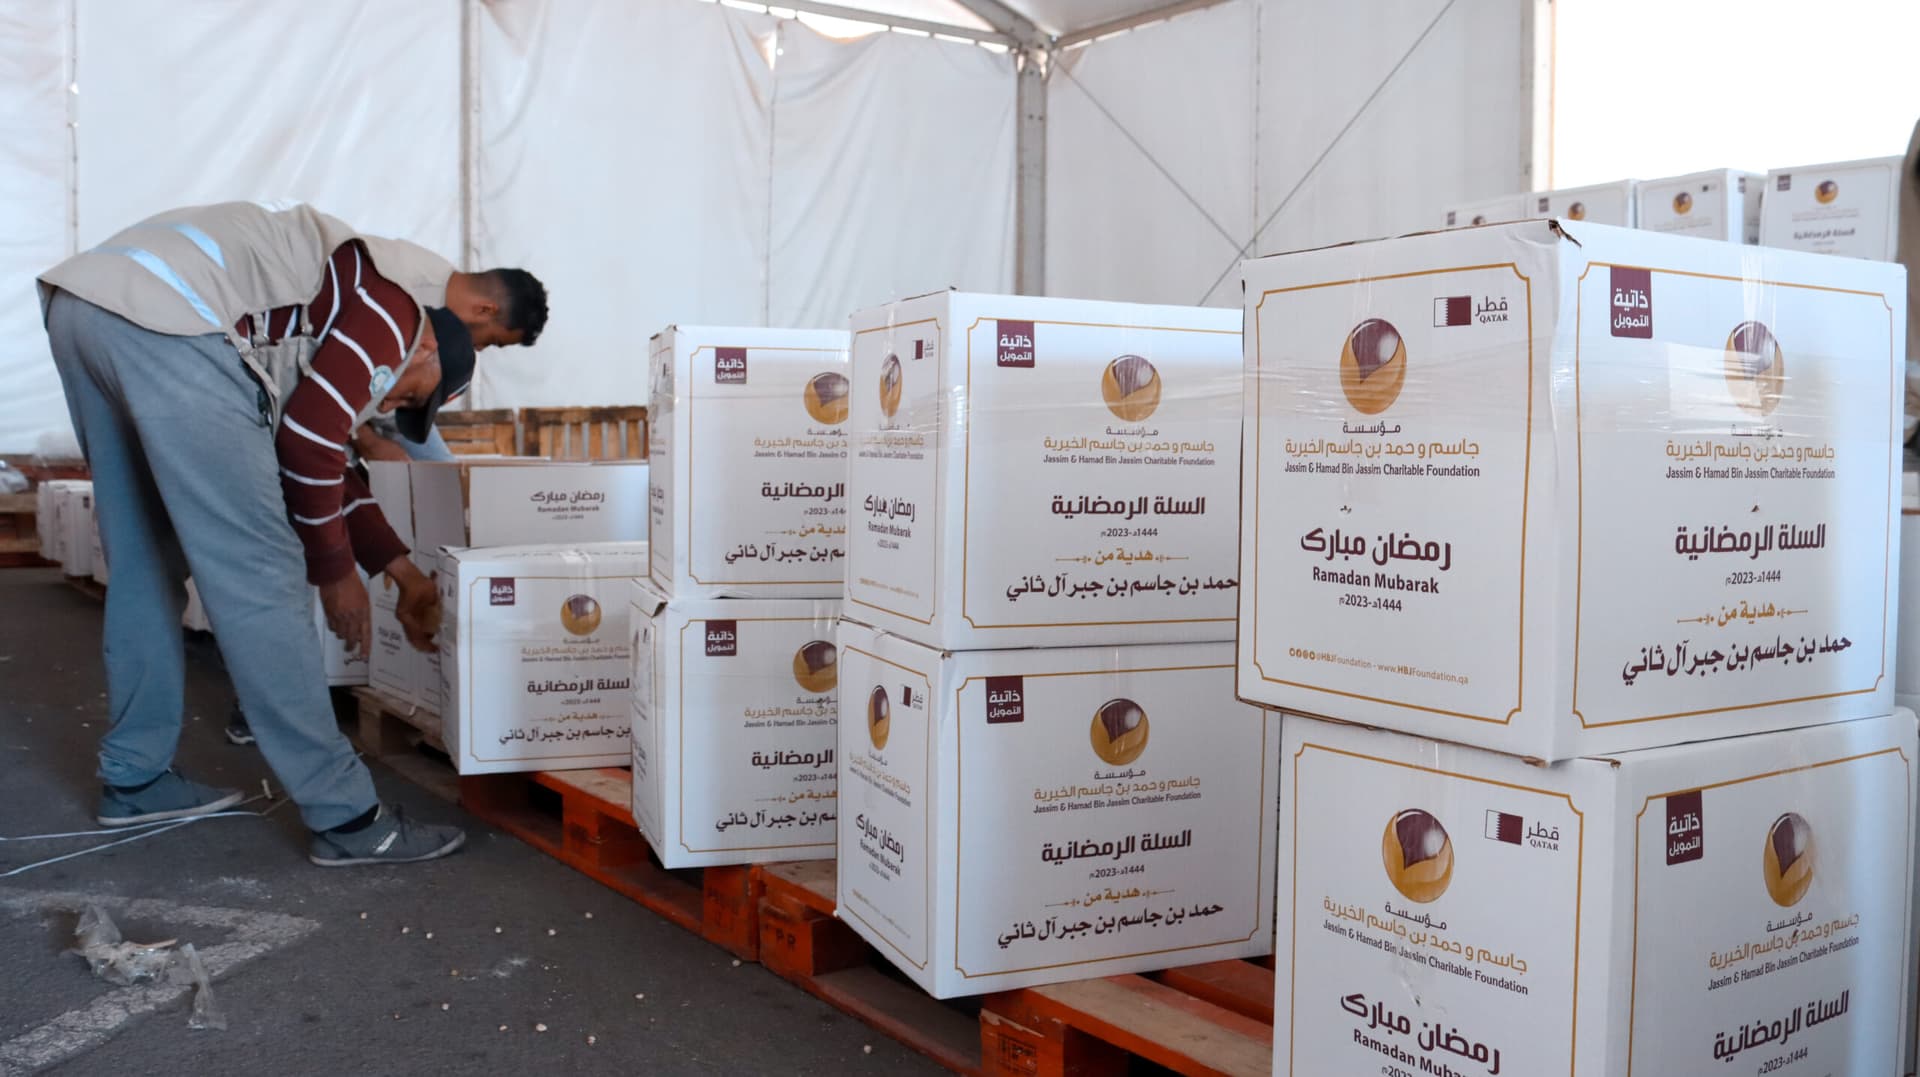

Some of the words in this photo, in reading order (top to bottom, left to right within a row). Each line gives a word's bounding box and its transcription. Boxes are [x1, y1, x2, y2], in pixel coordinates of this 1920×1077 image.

[1475, 296, 1508, 316] قطر
[1614, 288, 1648, 311] ذاتية
[1480, 314, 1508, 323] QATAR
[1614, 313, 1649, 328] التمويل
[1000, 334, 1032, 350] ذاتية
[717, 358, 744, 369] ذاتية
[1000, 352, 1032, 362] التمويل
[1106, 426, 1159, 438] مؤسسة
[1343, 421, 1401, 436] مؤسسة
[1286, 439, 1323, 456] الخيرية
[1327, 440, 1362, 456] جاسم
[1365, 446, 1381, 457] بن
[1387, 446, 1413, 454] حمد
[1419, 446, 1425, 458] و
[1429, 439, 1479, 459] جاسم
[1666, 441, 1711, 461] الخيرية
[1714, 443, 1751, 461] جاسم
[1754, 445, 1768, 461] بن
[1773, 444, 1793, 458] حمد
[1797, 448, 1802, 462] و
[1804, 444, 1834, 460] جاسم
[1043, 455, 1068, 464] Jassim
[1079, 455, 1103, 464] Hamad
[1106, 456, 1117, 464] Bin
[1119, 456, 1142, 464] Jassim
[1144, 456, 1177, 465] Charitable
[1179, 457, 1215, 466] Foundation
[1285, 462, 1307, 472] Jassim
[1309, 463, 1314, 472] &
[1316, 463, 1340, 474] Hamad
[1342, 463, 1353, 474] Bin
[1355, 463, 1381, 475] Jassim
[1384, 463, 1424, 476] Charitable
[1426, 464, 1479, 476] Foundation
[1666, 467, 1693, 479] Jassim
[1696, 467, 1701, 478] &
[1704, 467, 1729, 479] Hamad
[1731, 467, 1742, 478] Bin
[1744, 467, 1768, 479] Jassim
[1770, 467, 1801, 479] Charitable
[1803, 468, 1834, 479] Foundation
[531, 491, 567, 504] مبارك
[570, 491, 605, 503] رمضان
[762, 482, 844, 501] الرمضانية
[889, 497, 915, 522] رمضان
[1052, 496, 1147, 520] الرمضانية
[1154, 497, 1205, 515] السلة
[890, 524, 911, 538] Mubarak
[1778, 523, 1825, 550] السلة
[760, 542, 775, 562] آل
[1301, 528, 1365, 560] مبارك
[1373, 533, 1451, 571] رمضان
[1676, 525, 1773, 560] الرمضانية
[725, 545, 757, 564] ثاني
[778, 548, 807, 563] جبر
[810, 546, 827, 562] بن
[1095, 551, 1113, 564] من
[1117, 548, 1153, 564] هدية
[1007, 576, 1045, 601] ثاني
[1048, 573, 1068, 597] آل
[1071, 581, 1103, 598] جبر
[1106, 578, 1127, 596] بن
[1131, 574, 1175, 597] جاسم
[1179, 578, 1198, 595] بن
[1203, 575, 1239, 589] حمد
[1313, 567, 1370, 586] Ramadan
[1375, 573, 1439, 594] Mubarak
[1718, 606, 1736, 626] من
[1740, 600, 1775, 624] هدية
[708, 630, 734, 642] ذاتية
[1819, 634, 1852, 652] حمد
[1667, 639, 1690, 676] آل
[1727, 642, 1748, 670] بن
[1751, 634, 1794, 670] جاسم
[1796, 637, 1815, 662] بن
[1623, 644, 1665, 685] ثاني
[1685, 647, 1724, 677] جبر
[1378, 664, 1468, 684] www.HBJFoundation.qa
[528, 680, 593, 695] الرمضانية
[989, 690, 1020, 705] ذاتية
[989, 707, 1021, 718] التمويل
[752, 750, 833, 769] الرمضانية
[716, 812, 747, 832] ثاني
[750, 810, 766, 829] آل
[766, 815, 796, 830] جبر
[800, 811, 816, 826] بن
[1669, 813, 1699, 838] ذاتية
[1141, 830, 1191, 851] السلة
[1526, 822, 1559, 841] قطر
[1041, 836, 1135, 865] الرمضانية
[1529, 838, 1559, 851] QATAR
[1669, 837, 1700, 856] التمويل
[1083, 893, 1101, 907] من
[1104, 887, 1140, 905] هدية
[1166, 905, 1184, 925] بن
[1189, 904, 1223, 917] حمد
[1324, 896, 1364, 922] الخيرية
[1385, 902, 1446, 930] مؤسسة
[1038, 915, 1056, 941] آل
[1095, 915, 1114, 934] بن
[1118, 907, 1162, 931] جاسم
[1367, 915, 1406, 937] جاسم
[1767, 912, 1813, 932] مؤسسة
[998, 921, 1034, 949] ثاني
[1060, 921, 1092, 940] جبر
[1410, 930, 1426, 946] بن
[1431, 934, 1461, 953] حمد
[1465, 946, 1473, 960] و
[1323, 920, 1347, 937] Jassim
[1349, 928, 1354, 938] &
[1356, 930, 1382, 950] Hamad
[1384, 940, 1397, 955] Bin
[1399, 944, 1427, 964] Jassim
[1429, 953, 1472, 979] Charitable
[1475, 970, 1528, 995] Foundation
[1477, 948, 1527, 975] جاسم
[1708, 975, 1732, 990] Jassim
[1733, 972, 1739, 983] &
[1741, 966, 1764, 982] Hamad
[1765, 963, 1775, 974] Bin
[1777, 956, 1798, 972] Jassim
[1799, 944, 1827, 963] Charitable
[1829, 935, 1859, 954] Foundation
[1341, 993, 1410, 1035] مبارك
[1806, 990, 1849, 1027] السلة
[1714, 1008, 1801, 1063] الرمضانية
[1354, 1028, 1415, 1067] Ramadan
[1418, 1022, 1500, 1075] رمضان
